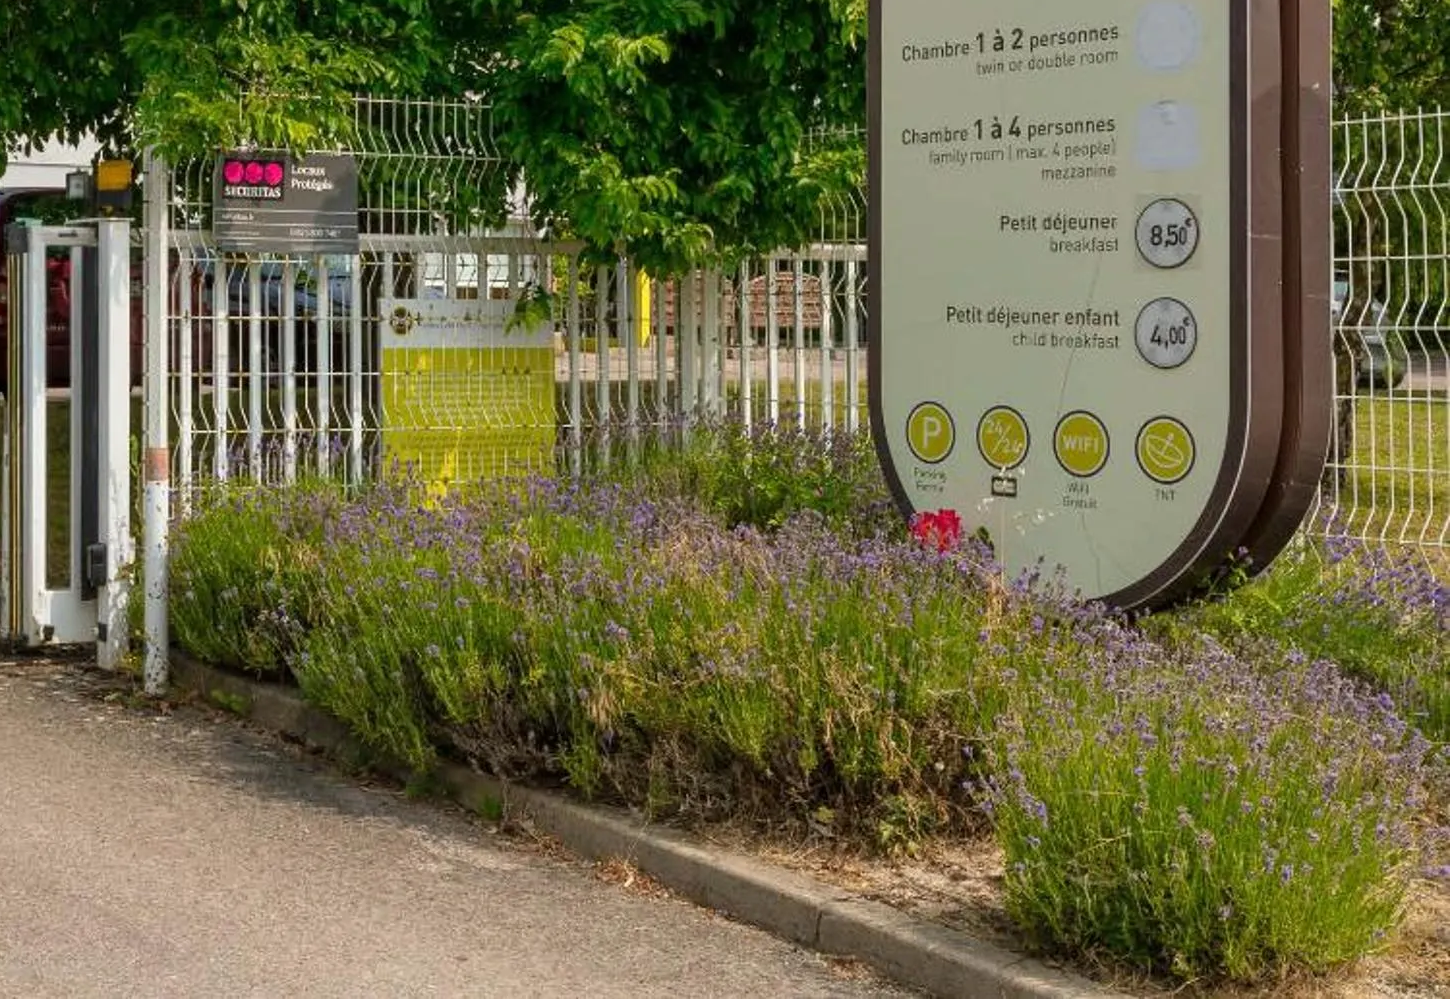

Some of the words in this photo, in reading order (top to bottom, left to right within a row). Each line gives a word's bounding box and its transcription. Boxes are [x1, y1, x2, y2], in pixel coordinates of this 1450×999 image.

[902, 40, 970, 62] Chambre
[976, 32, 984, 53] 1
[993, 29, 1004, 51] à
[1011, 28, 1024, 50] 2
[1030, 26, 1119, 50] personnes
[976, 60, 1004, 75] twin
[1009, 60, 1022, 72] or
[1028, 53, 1076, 71] double
[1081, 51, 1119, 65] room
[901, 128, 968, 145] Chambre
[974, 119, 982, 140] 1
[991, 117, 1002, 139] à
[1009, 116, 1021, 138] 4
[1028, 118, 1116, 141] personnes
[1053, 143, 1061, 157] 4
[1041, 164, 1117, 180] mezzanine
[1001, 215, 1037, 232] Petit
[1043, 212, 1118, 234] déjeuner
[1050, 236, 1119, 253] breakfast
[947, 305, 982, 325] Petit
[987, 305, 1059, 328] déjeuner
[1064, 308, 1119, 326] enfant
[1012, 331, 1045, 347] child
[1051, 331, 1119, 349] breakfast
[1062, 434, 1099, 453] WIFI
